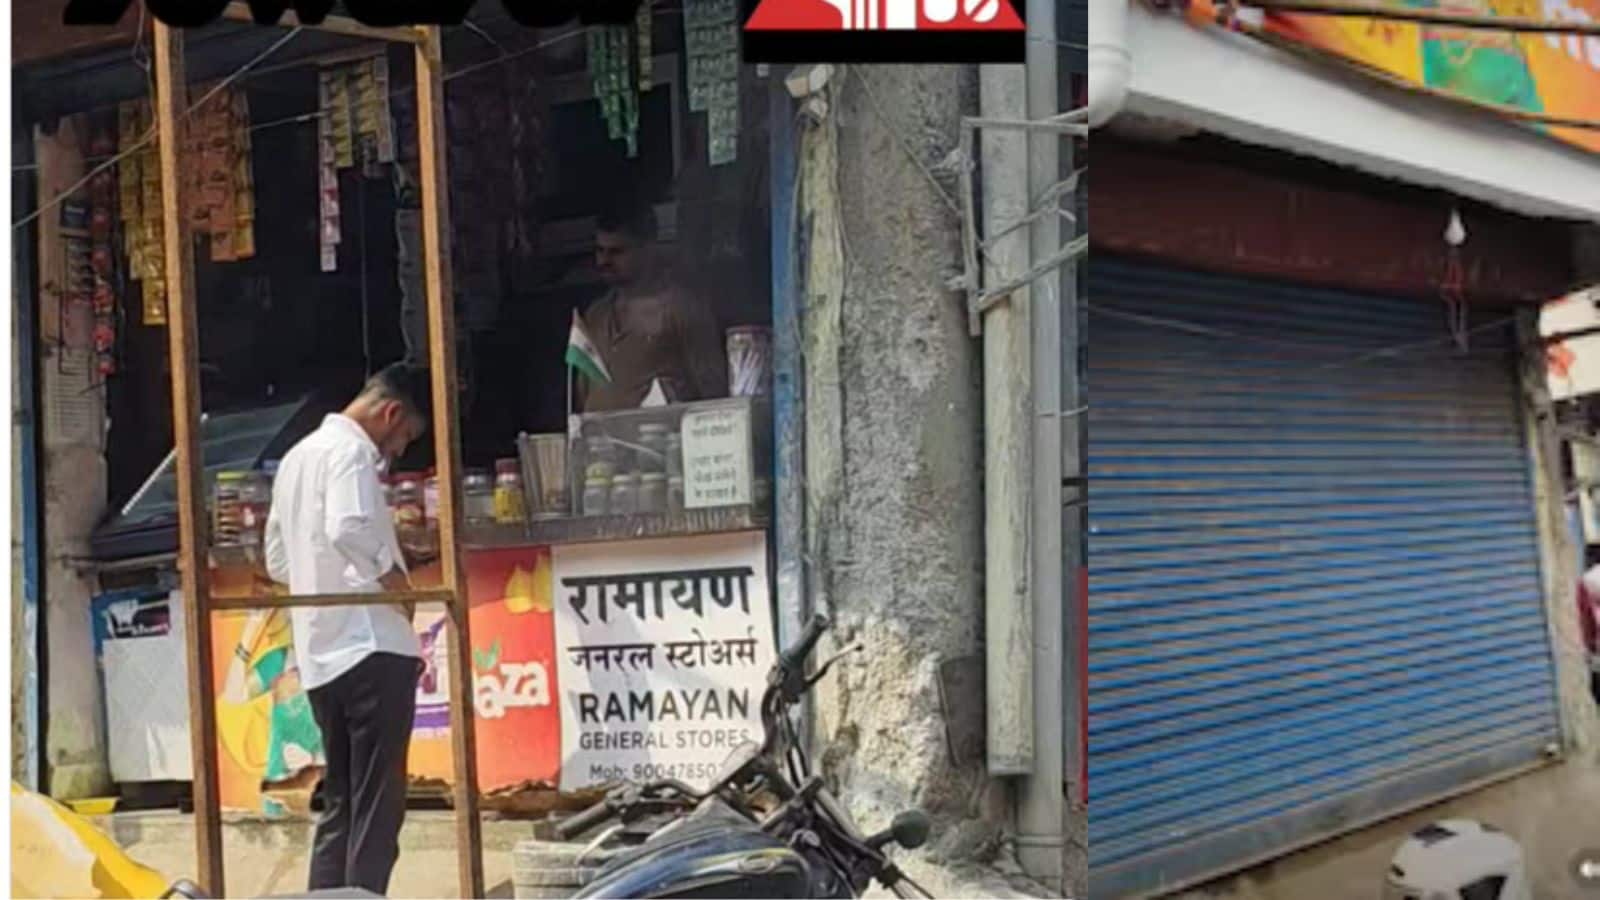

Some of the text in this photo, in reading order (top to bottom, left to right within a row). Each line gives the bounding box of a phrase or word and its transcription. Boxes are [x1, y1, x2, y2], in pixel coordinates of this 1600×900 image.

[561, 566, 754, 625] रामायण
[567, 642, 656, 673] जनरल
[579, 687, 749, 723] RAMAYAN
[579, 728, 750, 751] GENERAL STORES
